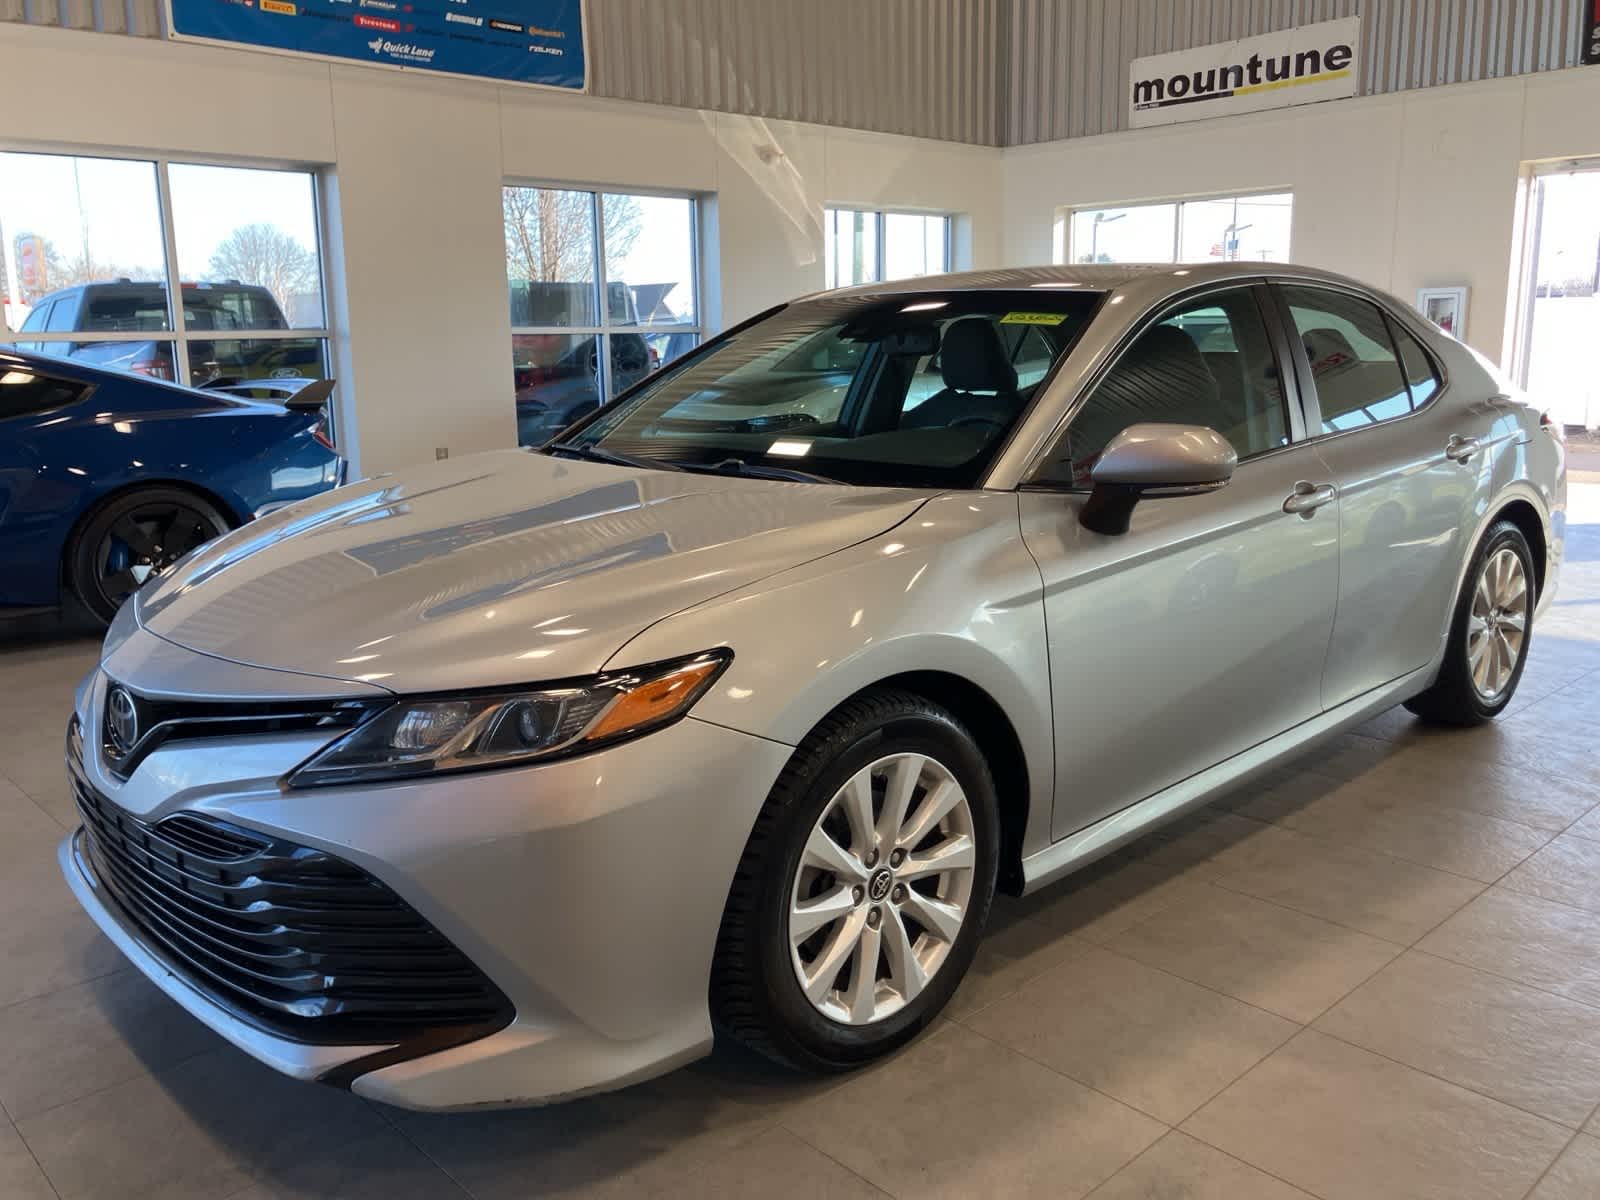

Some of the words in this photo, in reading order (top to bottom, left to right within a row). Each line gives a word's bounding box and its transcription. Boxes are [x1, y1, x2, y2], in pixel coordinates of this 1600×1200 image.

[382, 40, 410, 54] Quick
[410, 45, 434, 58] Lane
[1133, 45, 1353, 104] mountune
